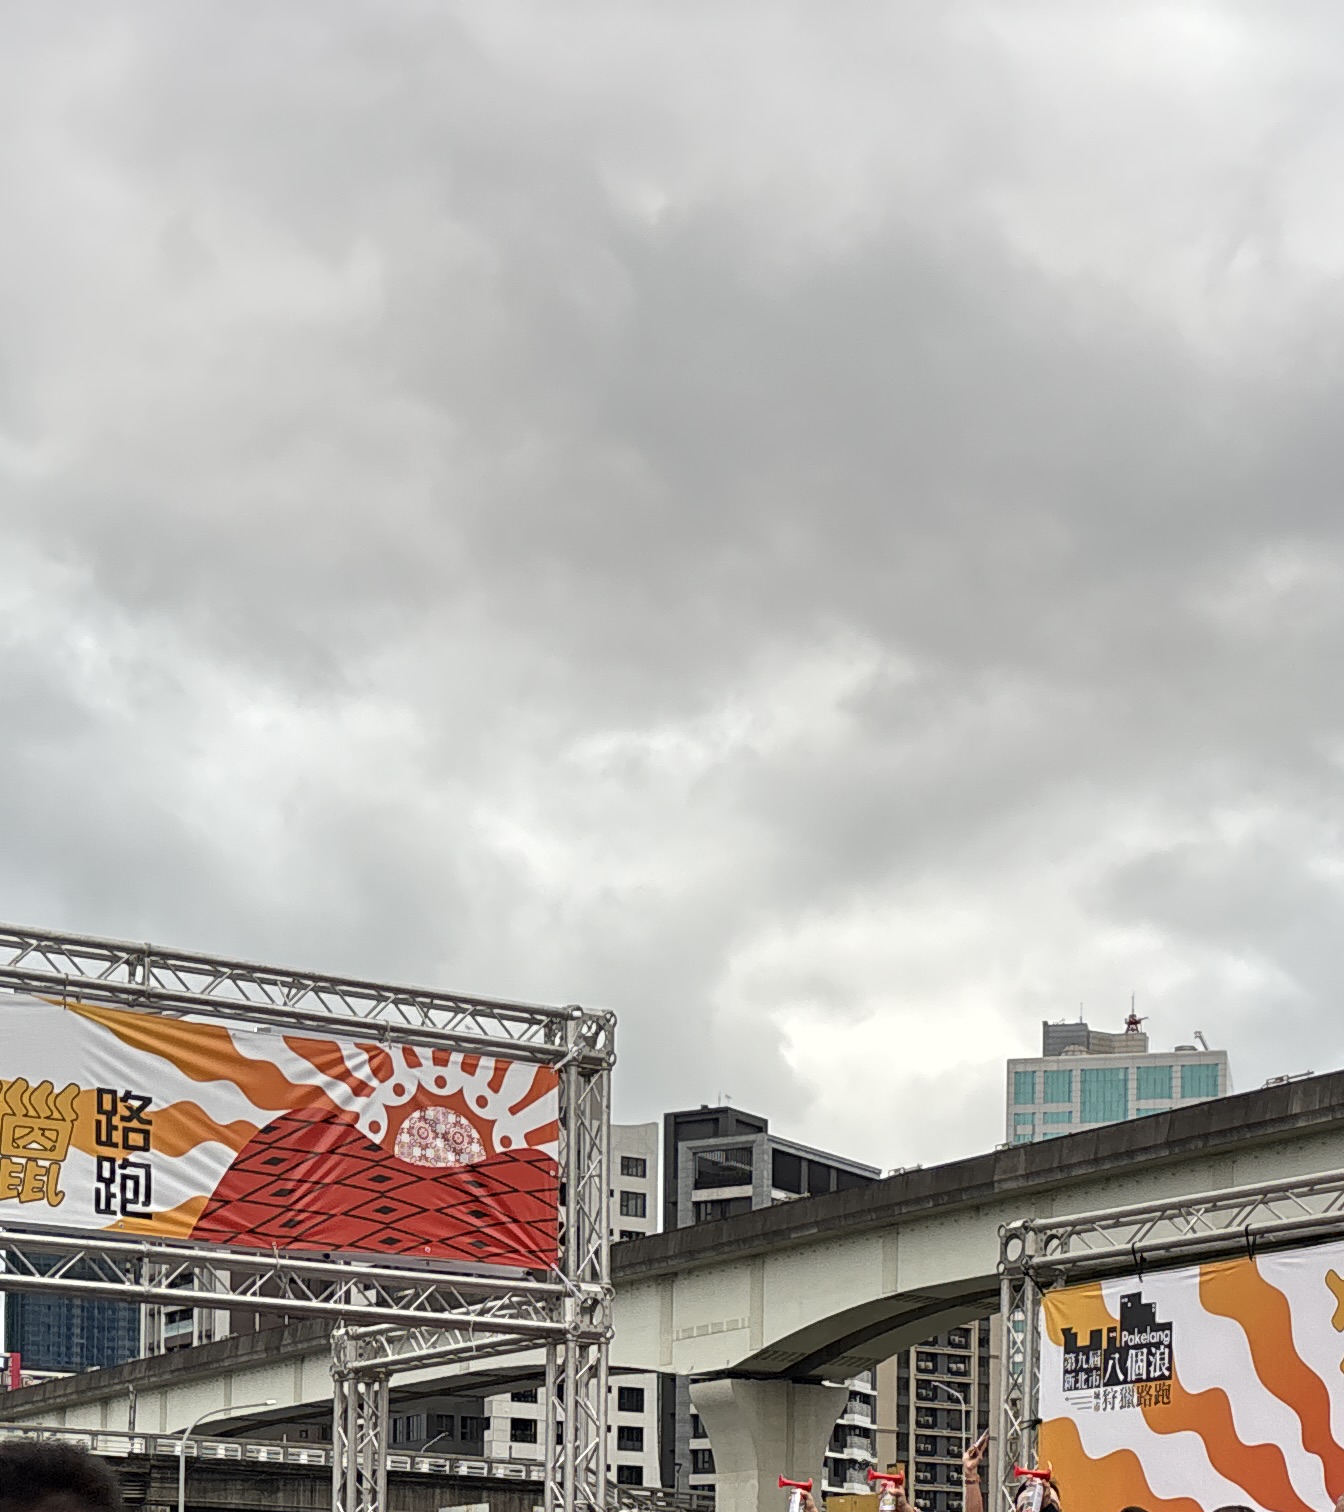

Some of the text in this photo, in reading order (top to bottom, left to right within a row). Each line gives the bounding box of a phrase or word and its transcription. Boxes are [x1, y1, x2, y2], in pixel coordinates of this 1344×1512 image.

[95, 1087, 153, 1220] 路跑
[1121, 1326, 1170, 1347] Pakelang
[1064, 1350, 1101, 1371] 第九屆
[1104, 1345, 1170, 1383] 八個浪
[1064, 1370, 1100, 1390] 新北市
